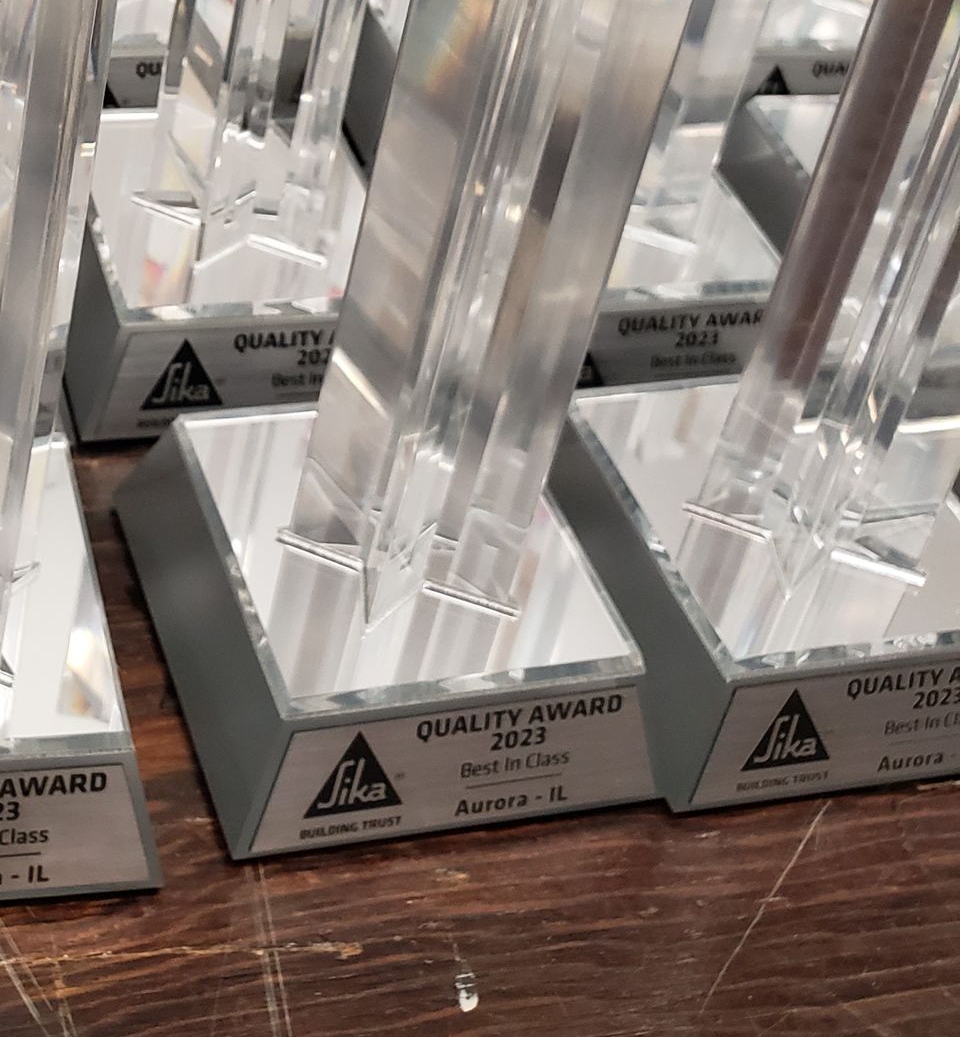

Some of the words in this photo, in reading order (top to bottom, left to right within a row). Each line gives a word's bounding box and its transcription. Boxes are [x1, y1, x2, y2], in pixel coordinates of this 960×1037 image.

[617, 313, 699, 337] QUALITY
[706, 308, 764, 327] AWAR
[234, 328, 325, 353] QUALITY
[297, 348, 331, 367] 202
[151, 362, 210, 403] Sika
[847, 668, 944, 700] QUALITY
[416, 709, 523, 743] QUALITY
[528, 694, 624, 725] AWARD
[884, 718, 920, 735] Best
[490, 726, 547, 751] 2023
[752, 713, 818, 764] Sika
[460, 760, 500, 779] Best
[504, 756, 521, 771] In
[526, 750, 571, 769] Class
[877, 752, 944, 772] Aurora
[316, 757, 387, 809] Sika
[736, 777, 790, 792] BUILDING
[792, 771, 829, 784] TRUST
[454, 794, 528, 816] Aurora
[549, 785, 568, 803] IL
[299, 822, 358, 839] BUILDING
[362, 816, 401, 830] TRUST
[28, 864, 50, 883] IL
